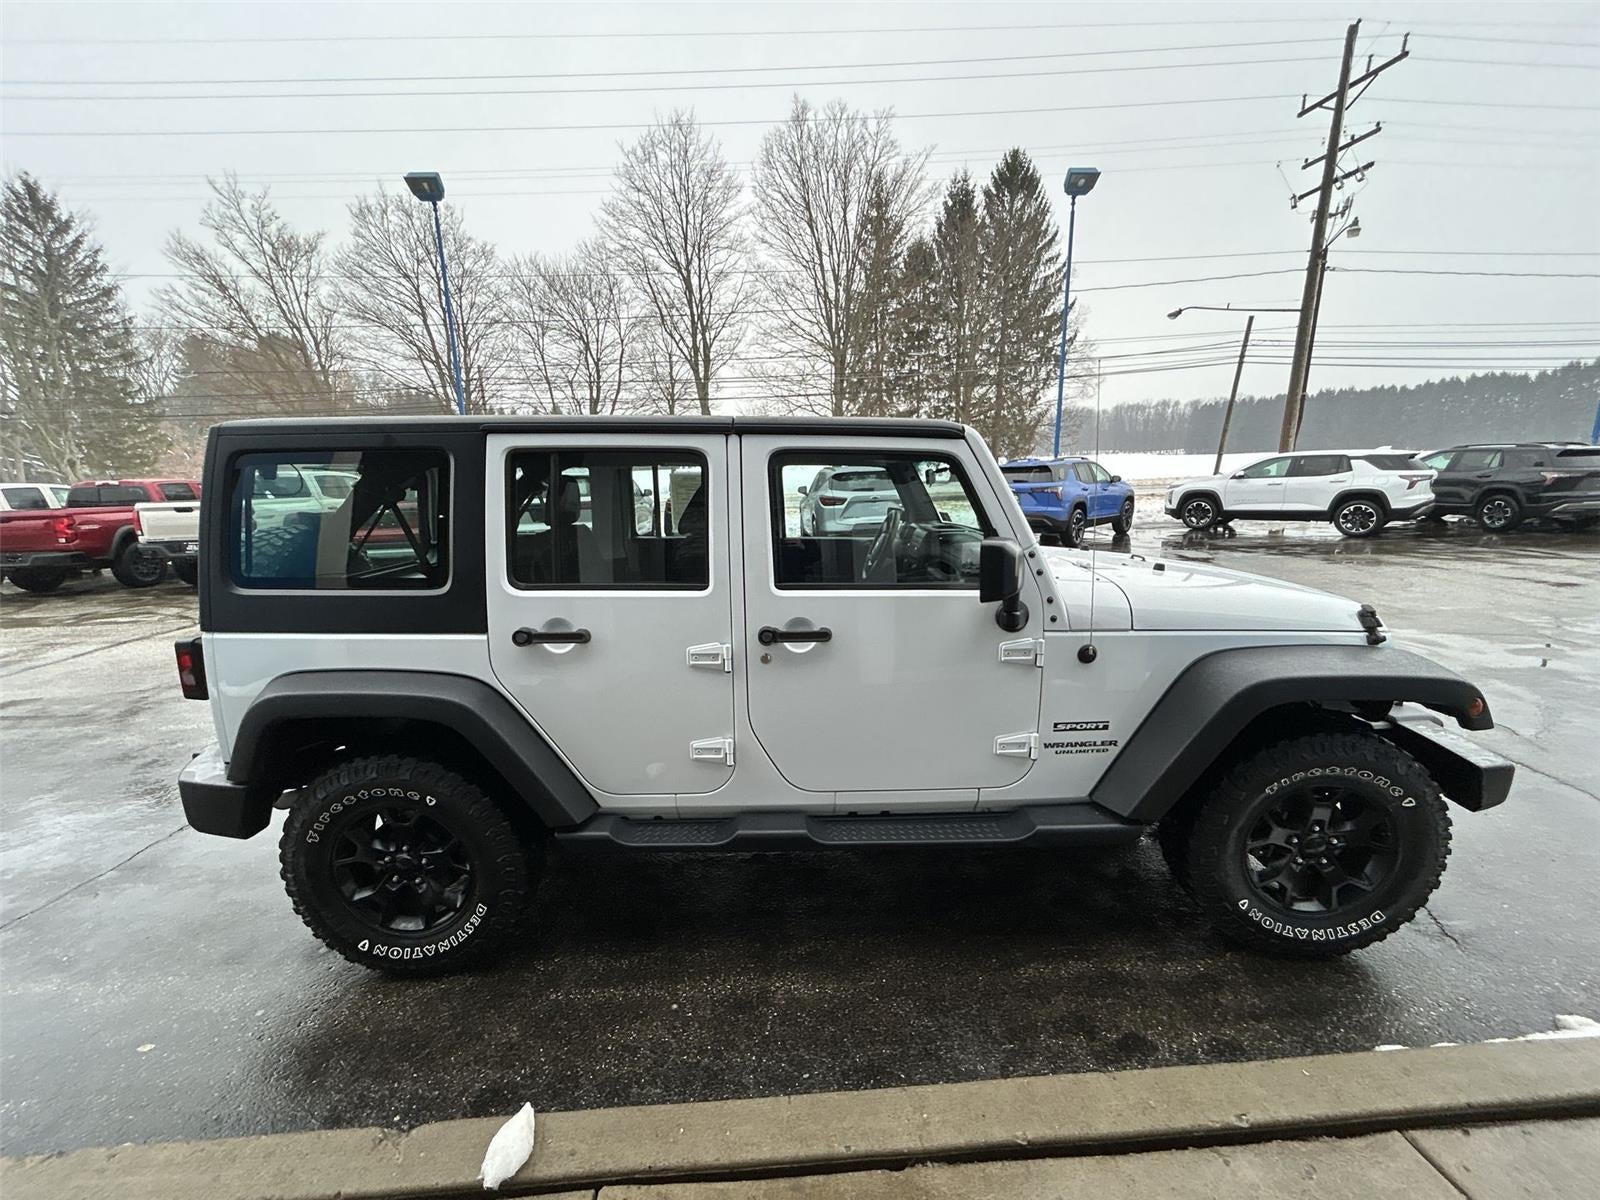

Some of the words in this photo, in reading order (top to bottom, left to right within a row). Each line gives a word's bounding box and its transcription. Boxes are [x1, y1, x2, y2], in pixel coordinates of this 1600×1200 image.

[1055, 722, 1106, 731] SPORT
[1043, 740, 1119, 749] WRANGLER
[373, 903, 488, 960] DESTINATION
[1249, 909, 1386, 941] DESTINATION
